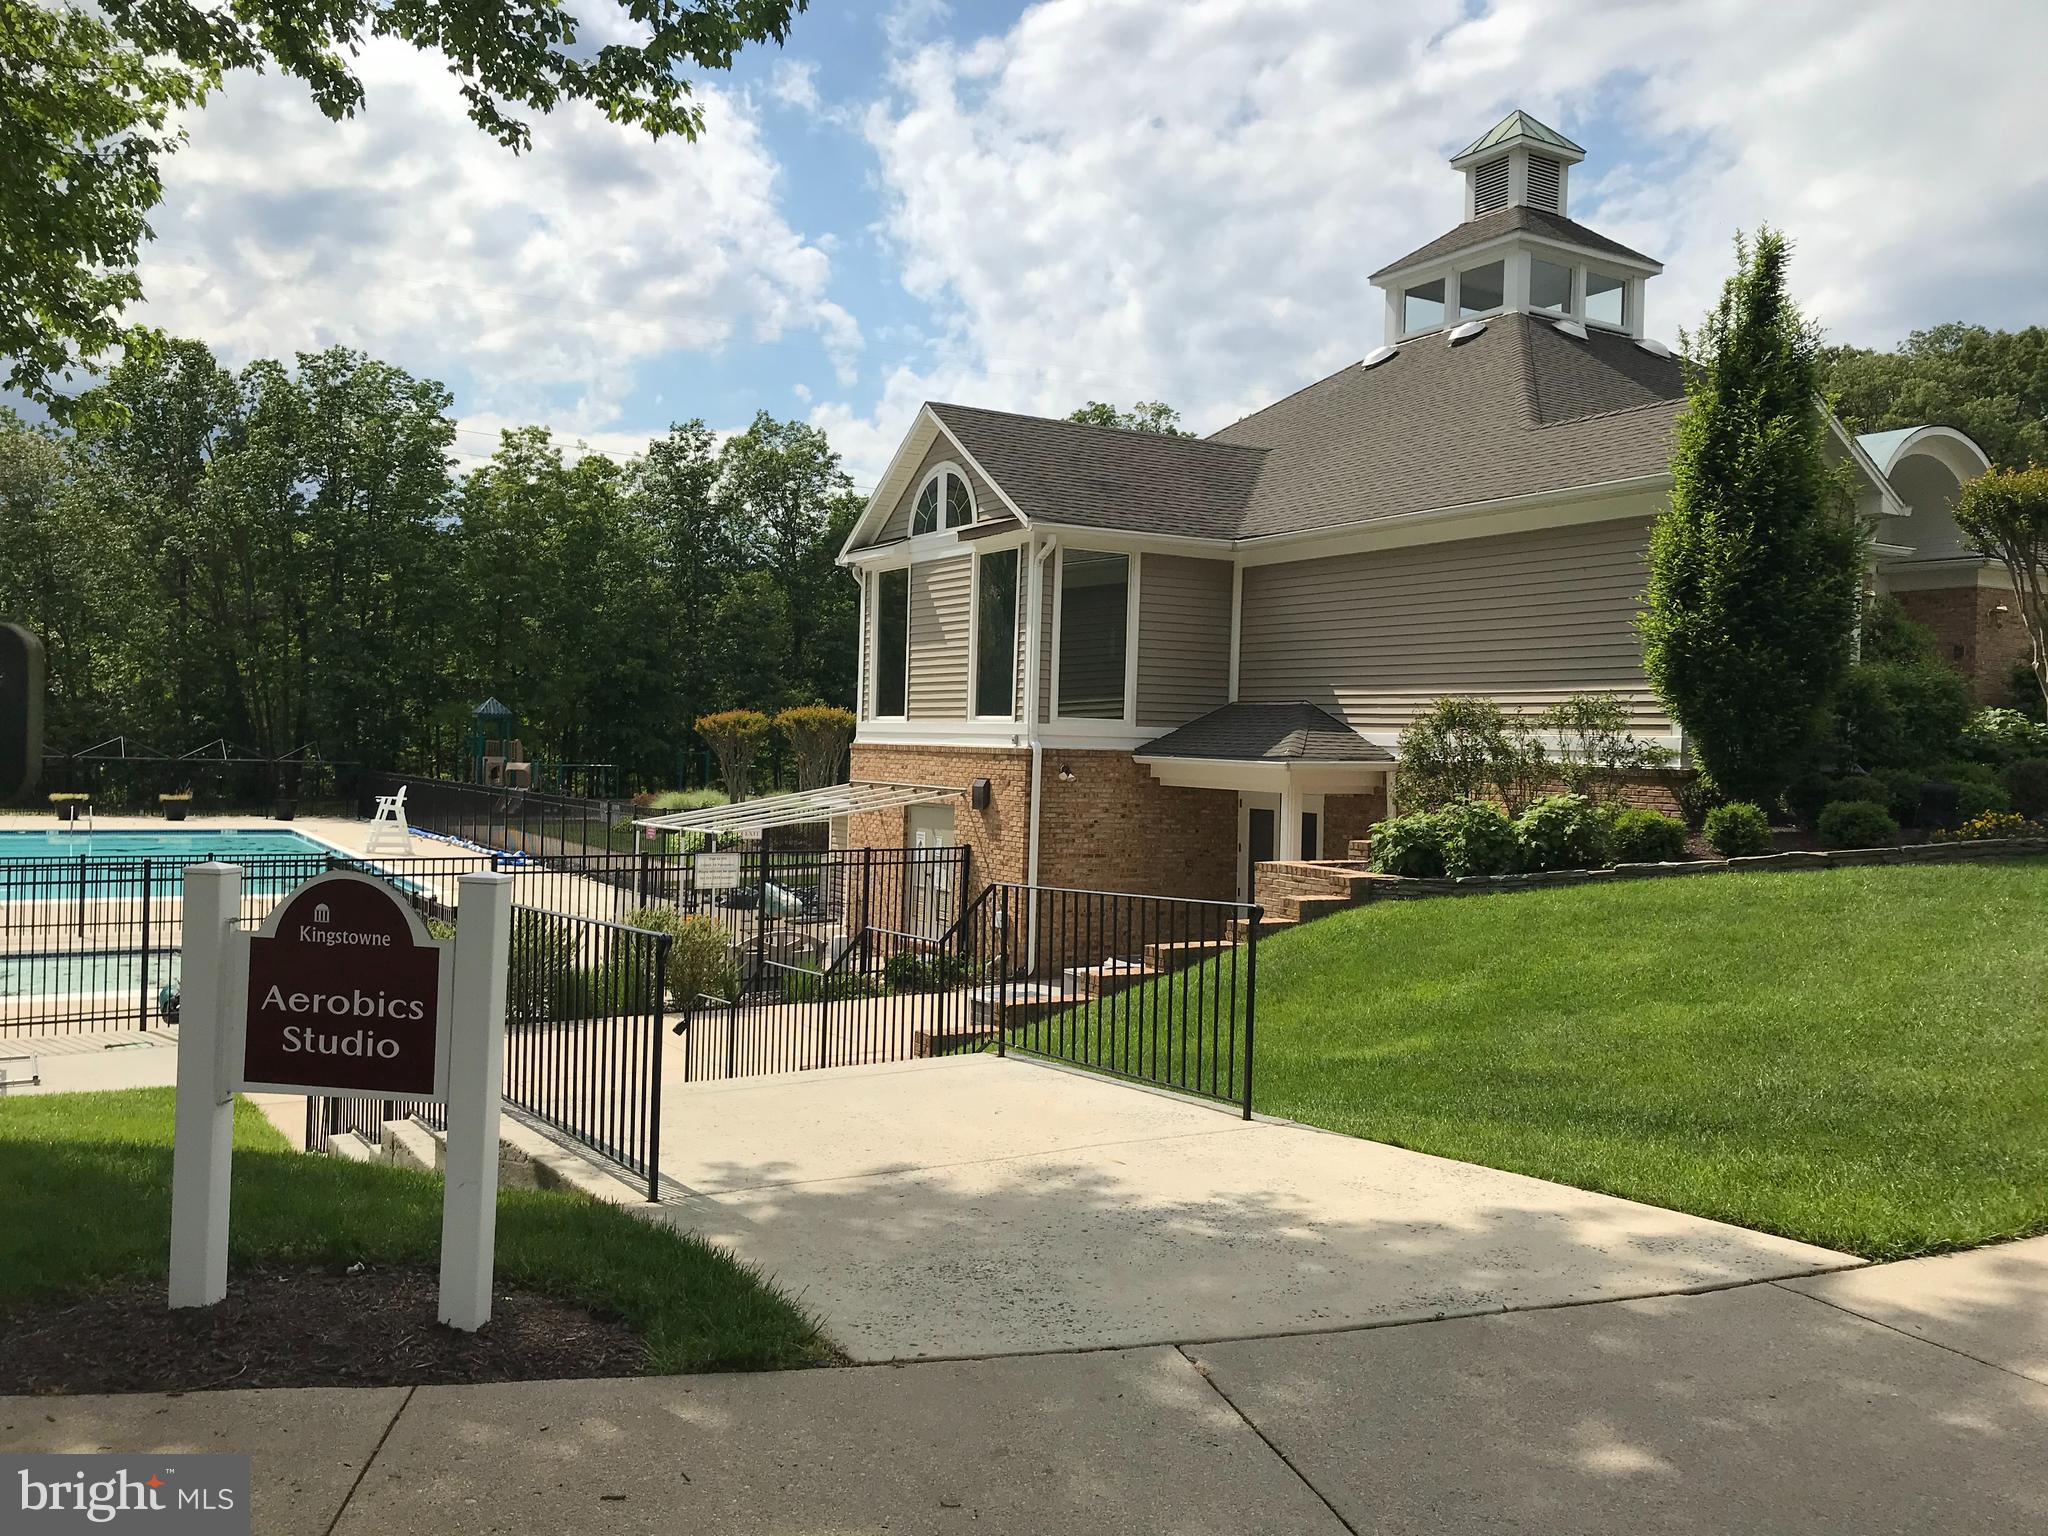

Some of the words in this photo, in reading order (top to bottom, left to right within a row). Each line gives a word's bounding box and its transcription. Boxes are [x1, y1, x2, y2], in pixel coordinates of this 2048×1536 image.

[300, 926, 390, 946] Kingstowne
[261, 985, 424, 1020] Aerobics
[282, 1026, 400, 1059] Studio
